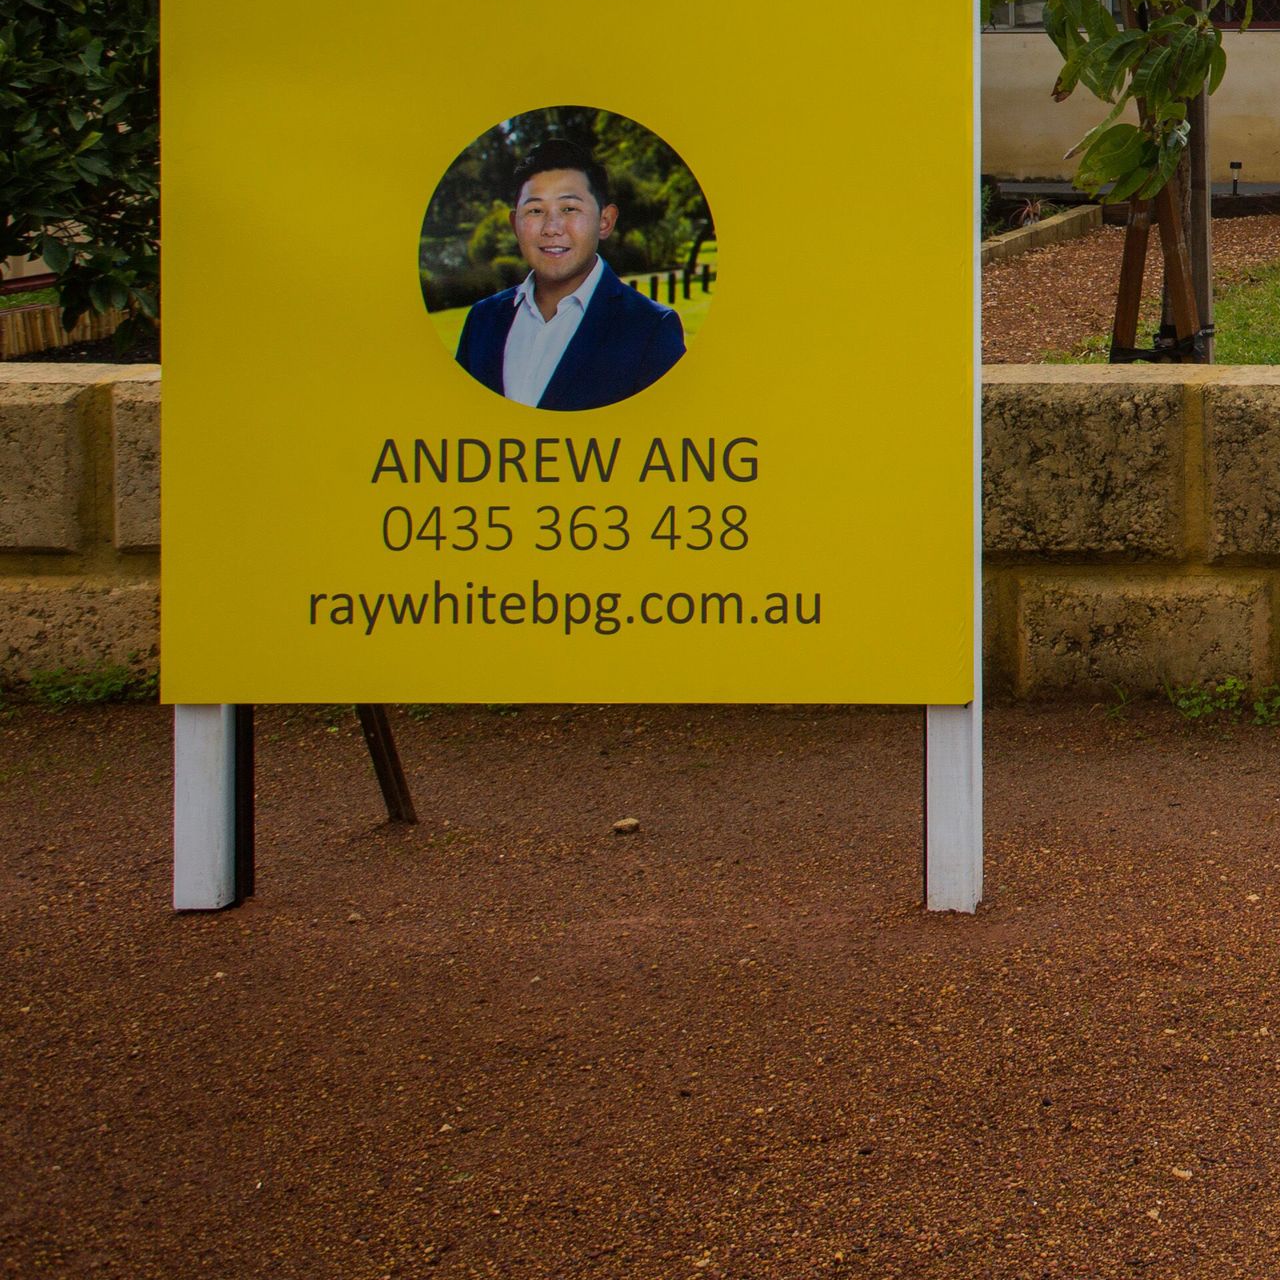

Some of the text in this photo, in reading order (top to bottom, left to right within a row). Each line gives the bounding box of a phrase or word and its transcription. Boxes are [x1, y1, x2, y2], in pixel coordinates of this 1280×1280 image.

[370, 436, 760, 484] ANDREW ANG
[381, 504, 751, 553] 0435 363 438
[308, 579, 823, 636] raywhitebpg.com.au
